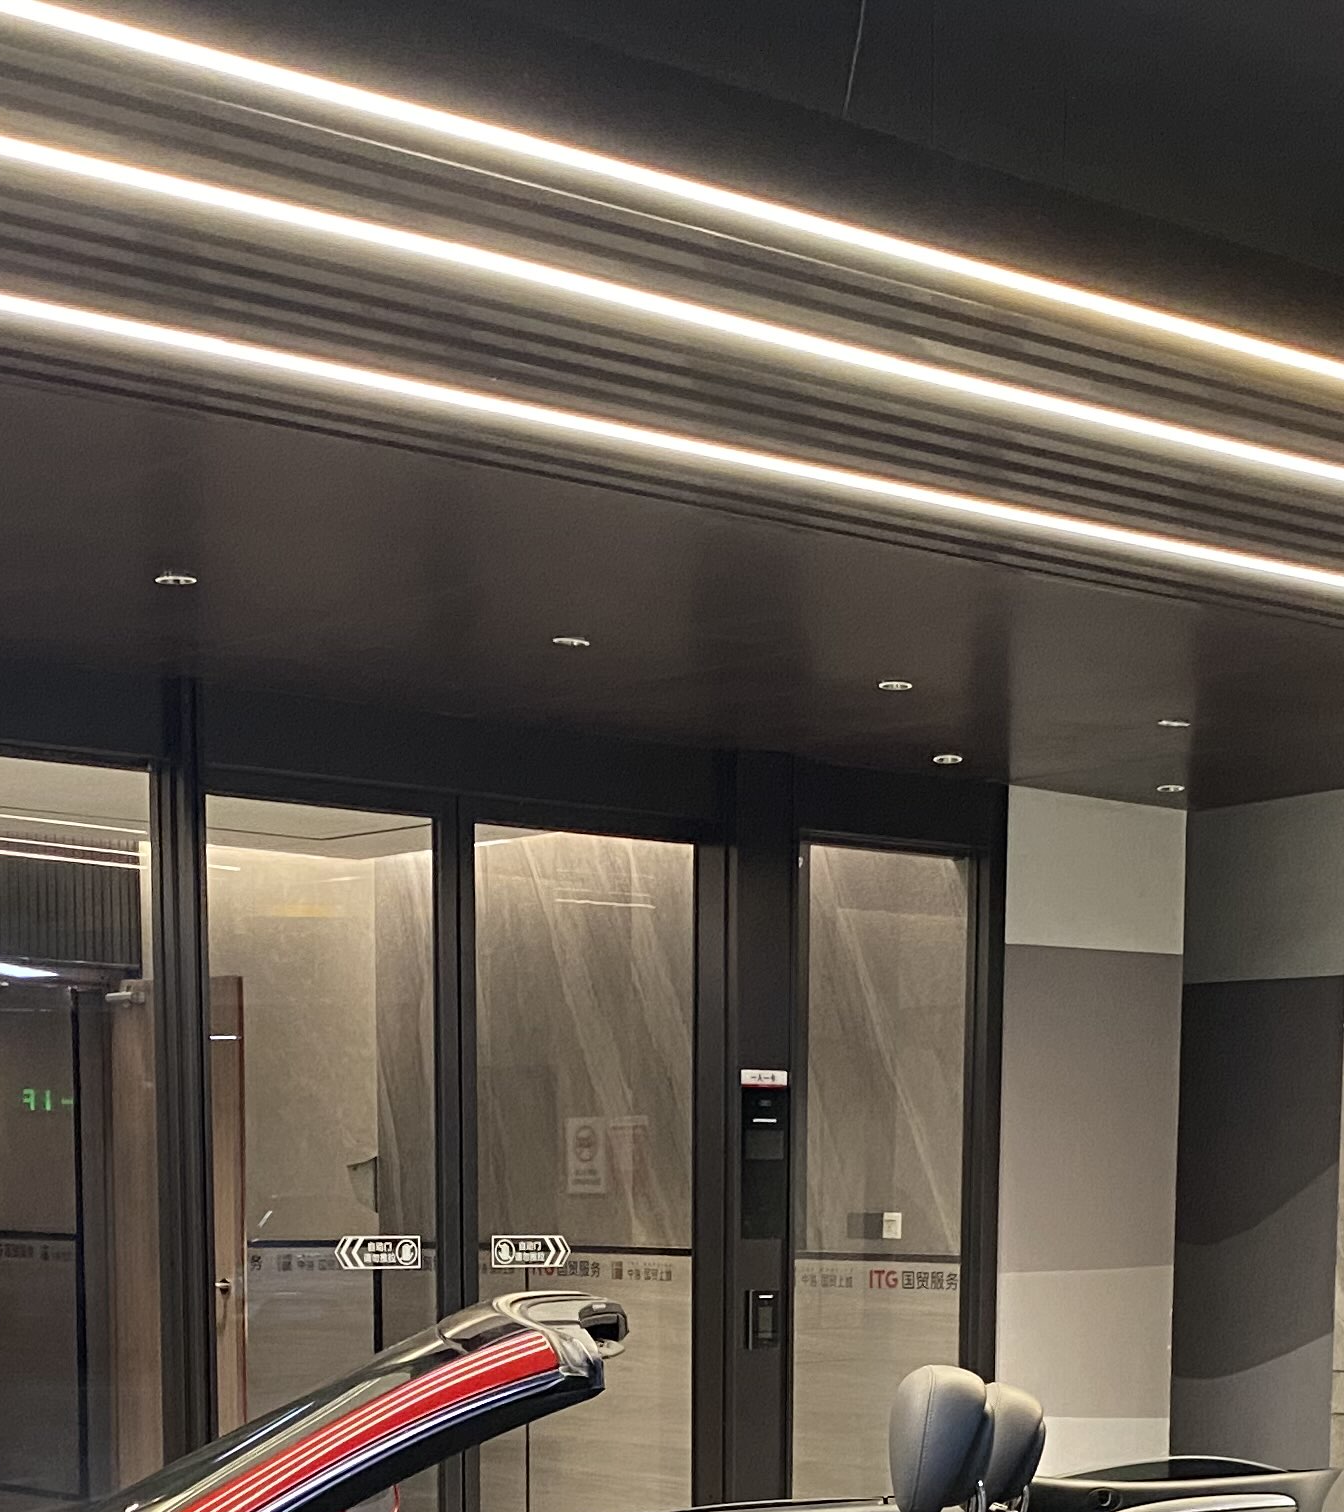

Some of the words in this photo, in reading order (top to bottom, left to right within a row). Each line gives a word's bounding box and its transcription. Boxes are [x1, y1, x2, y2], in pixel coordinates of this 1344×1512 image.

[869, 1269, 899, 1289] ITG
[902, 1270, 958, 1291] 国贸服务
